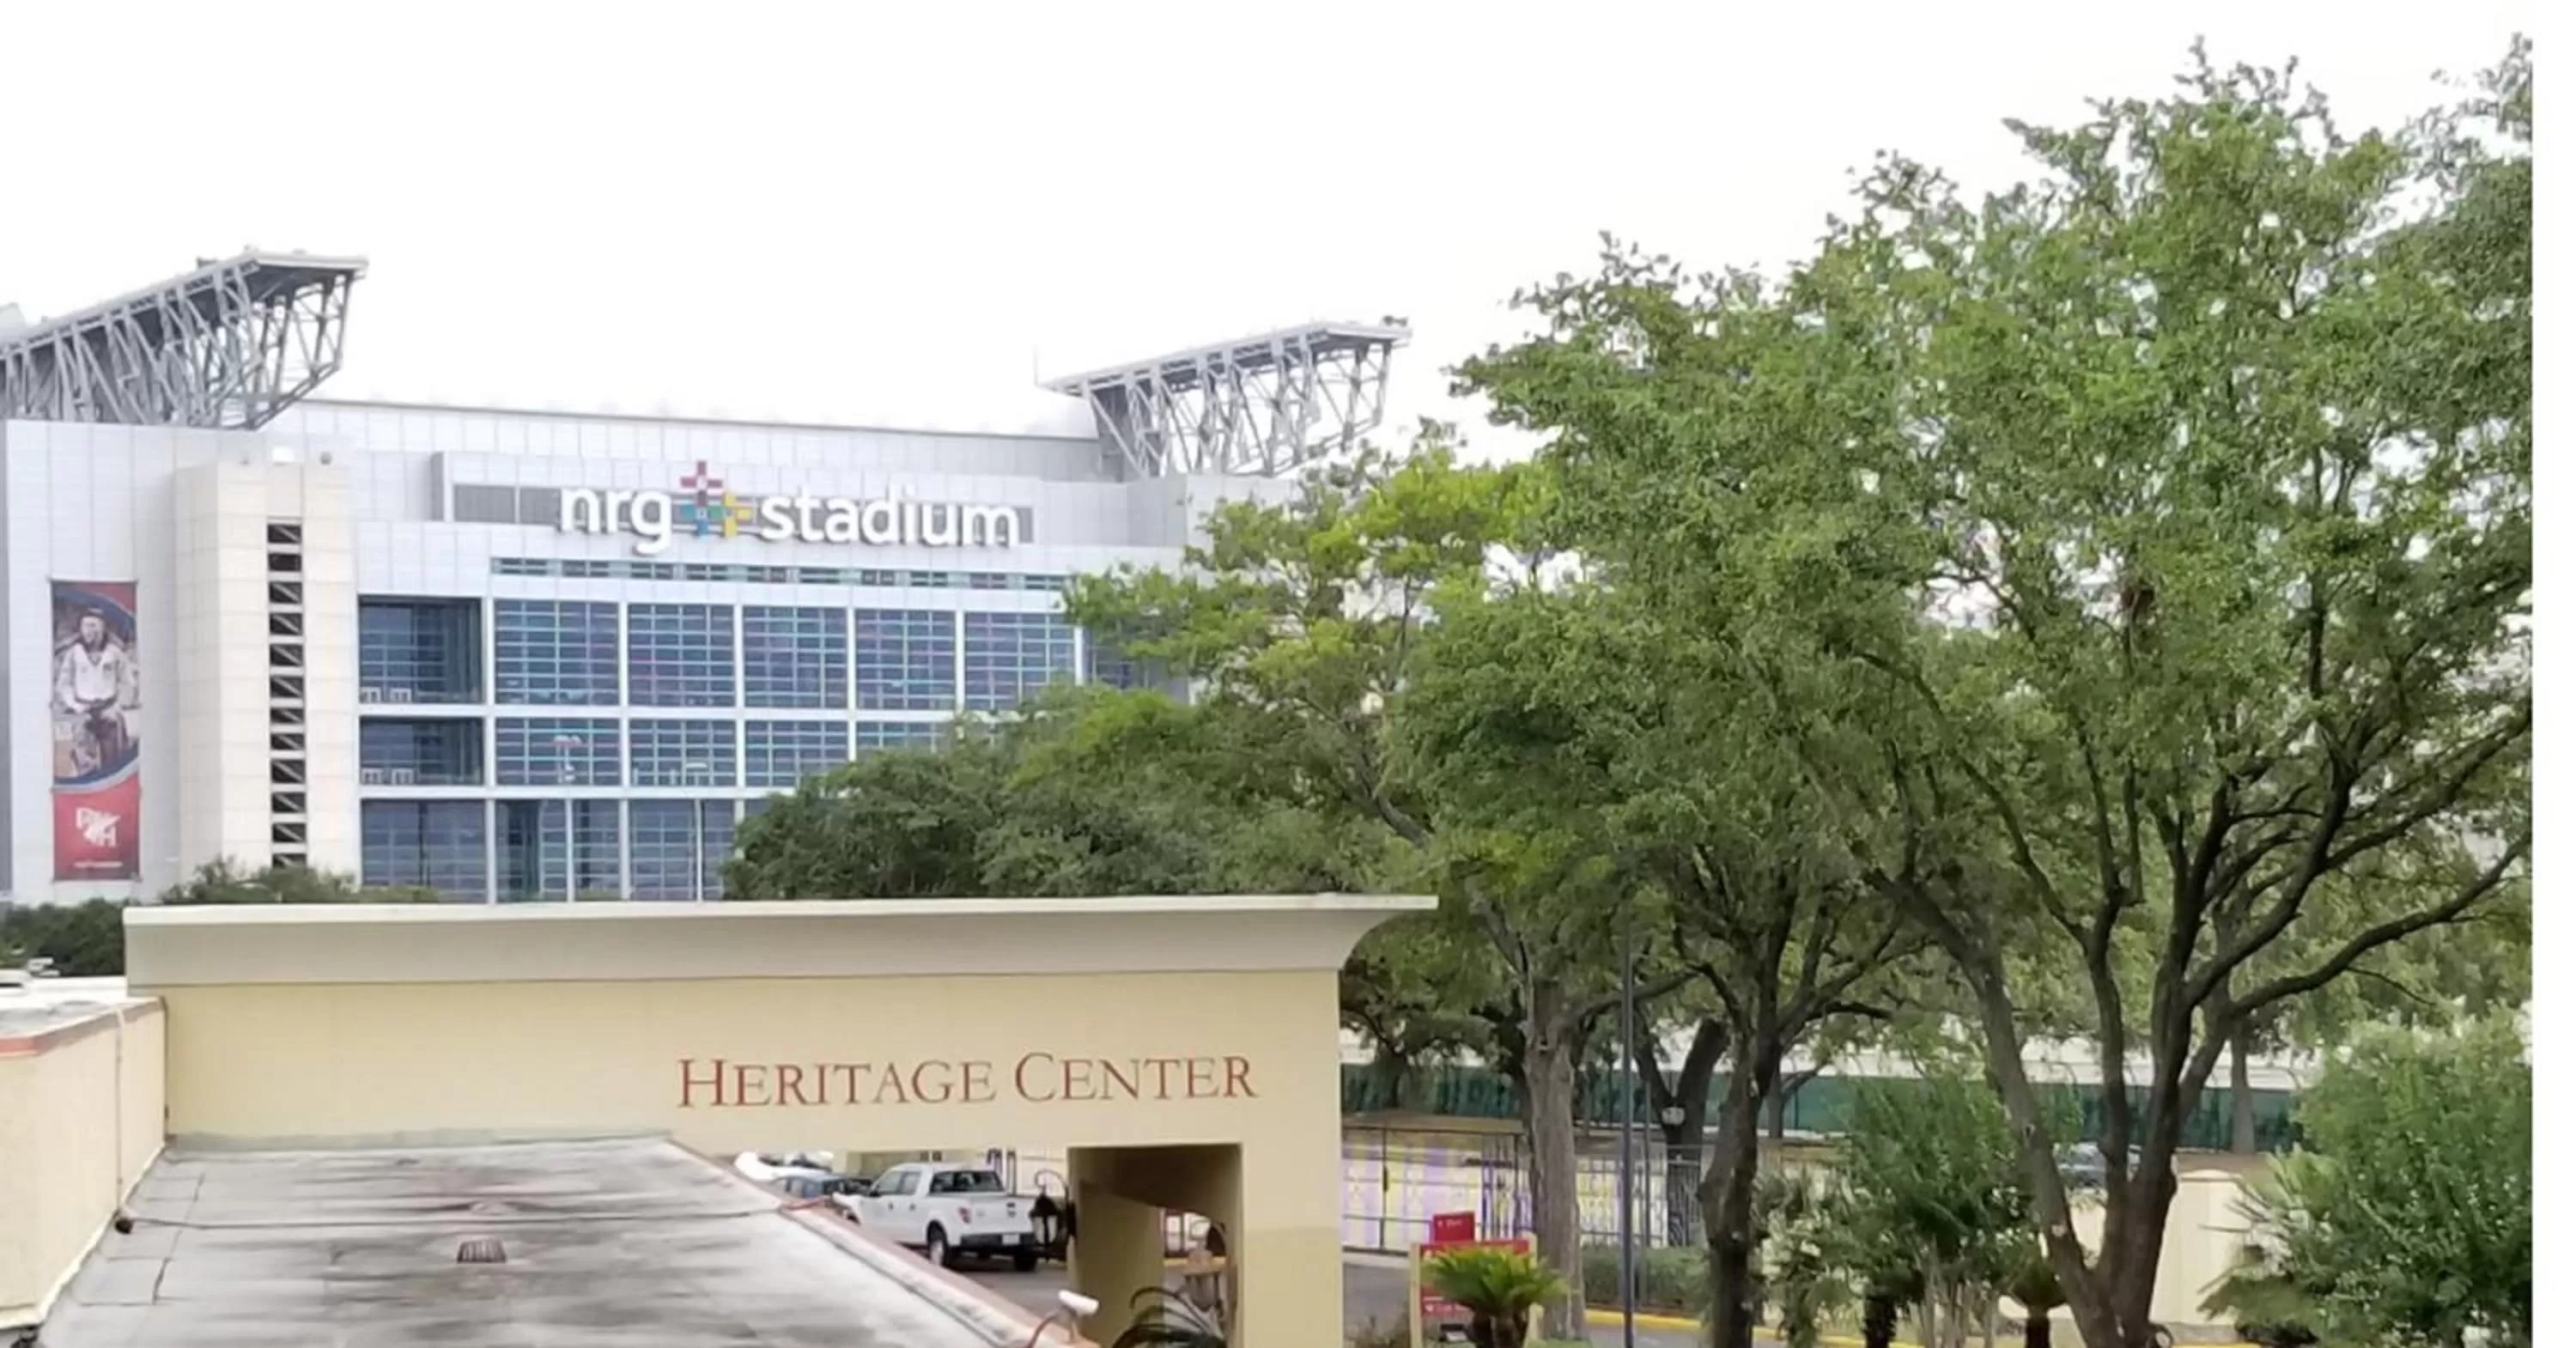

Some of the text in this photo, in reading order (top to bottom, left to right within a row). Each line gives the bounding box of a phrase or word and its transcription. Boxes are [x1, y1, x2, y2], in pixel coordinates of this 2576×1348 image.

[561, 481, 1021, 555] nrg stadium
[677, 1052, 1258, 1108] HERITAGE CENTER
